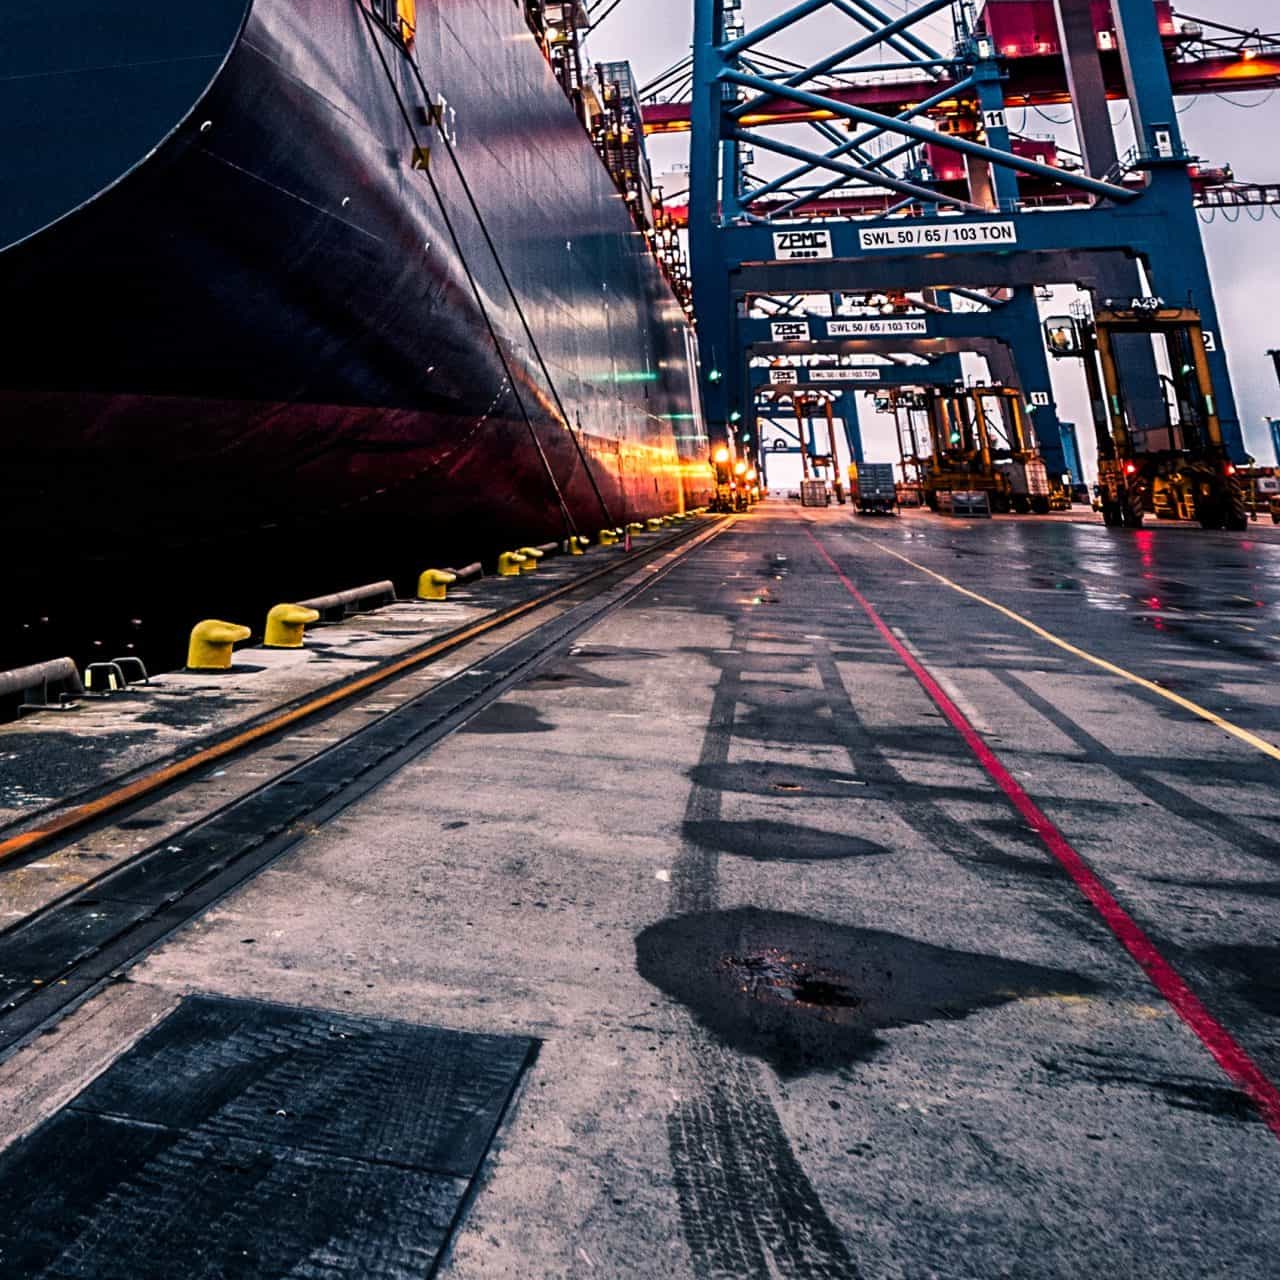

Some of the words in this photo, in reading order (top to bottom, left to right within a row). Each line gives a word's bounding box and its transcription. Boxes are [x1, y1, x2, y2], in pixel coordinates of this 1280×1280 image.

[986, 112, 1004, 126] 11
[777, 232, 827, 249] ZPMC
[863, 232, 894, 246] SWL
[897, 231, 913, 243] 50
[924, 229, 941, 242] 65
[953, 228, 977, 240] 103
[979, 226, 1012, 239] TON
[830, 323, 849, 333] SWL
[852, 323, 863, 332] 50
[869, 322, 881, 331] 65
[888, 322, 904, 331] 103
[905, 321, 925, 330] TON
[1034, 394, 1046, 404] 11
